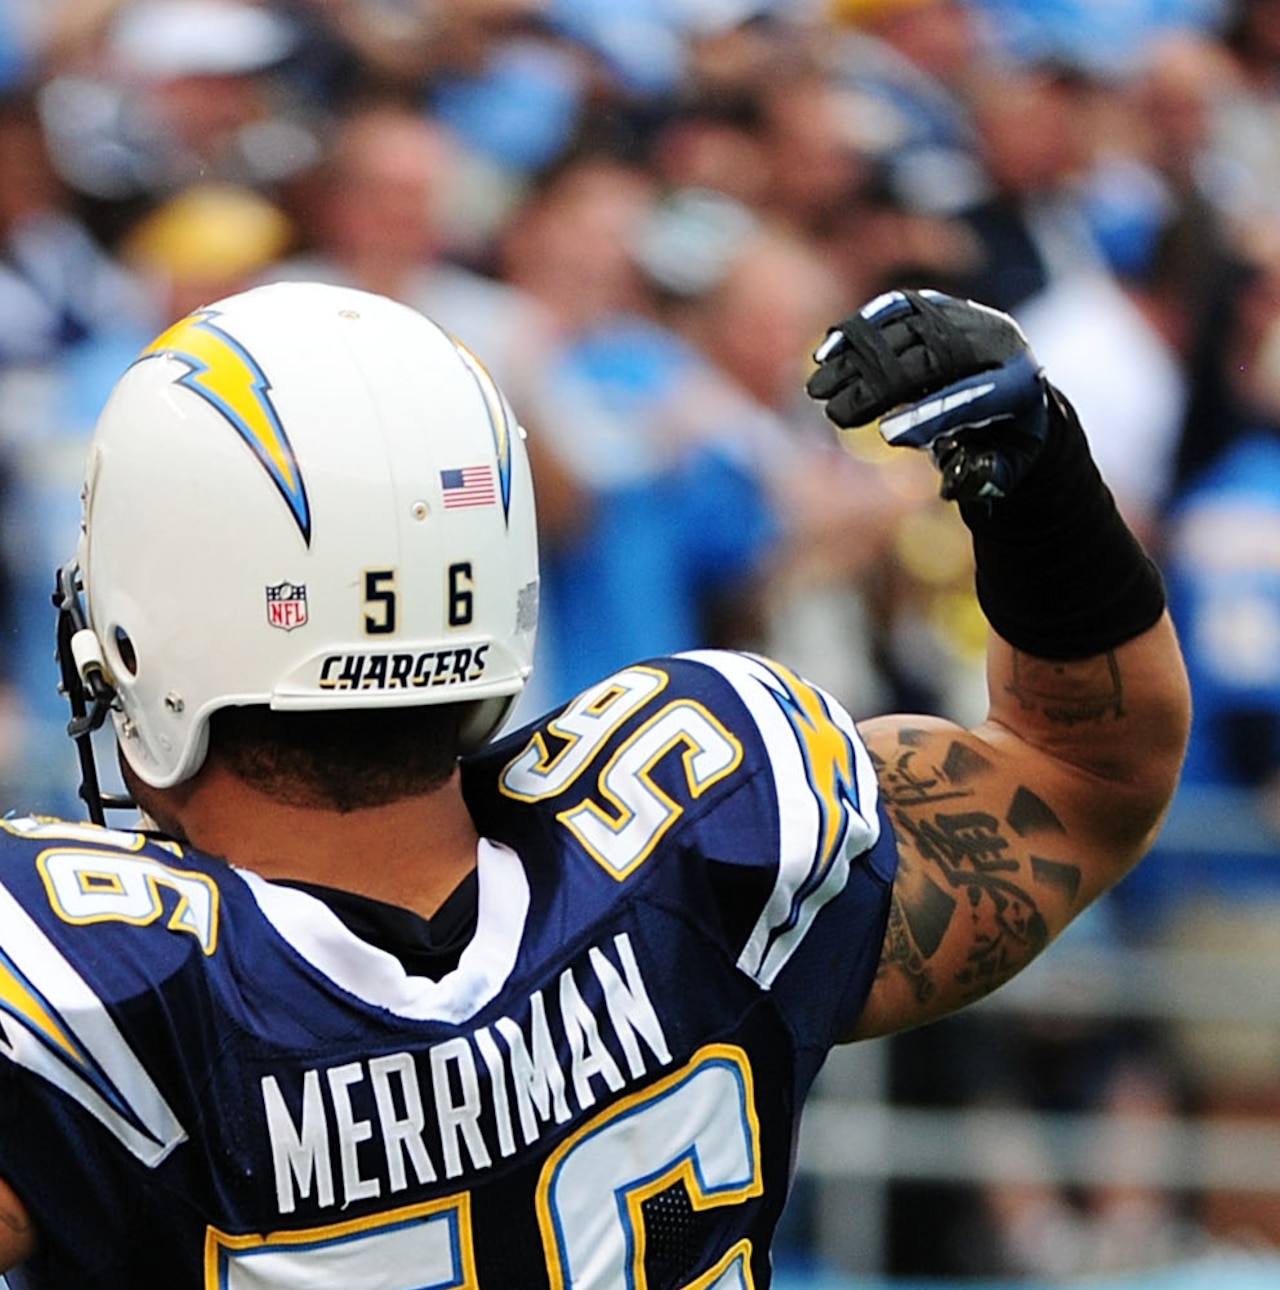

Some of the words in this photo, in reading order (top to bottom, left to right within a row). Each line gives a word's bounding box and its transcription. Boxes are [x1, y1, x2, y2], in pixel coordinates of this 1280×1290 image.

[270, 602, 306, 624] NFL
[320, 643, 491, 690] CHARGERS
[260, 932, 673, 1214] MERRIMAN
